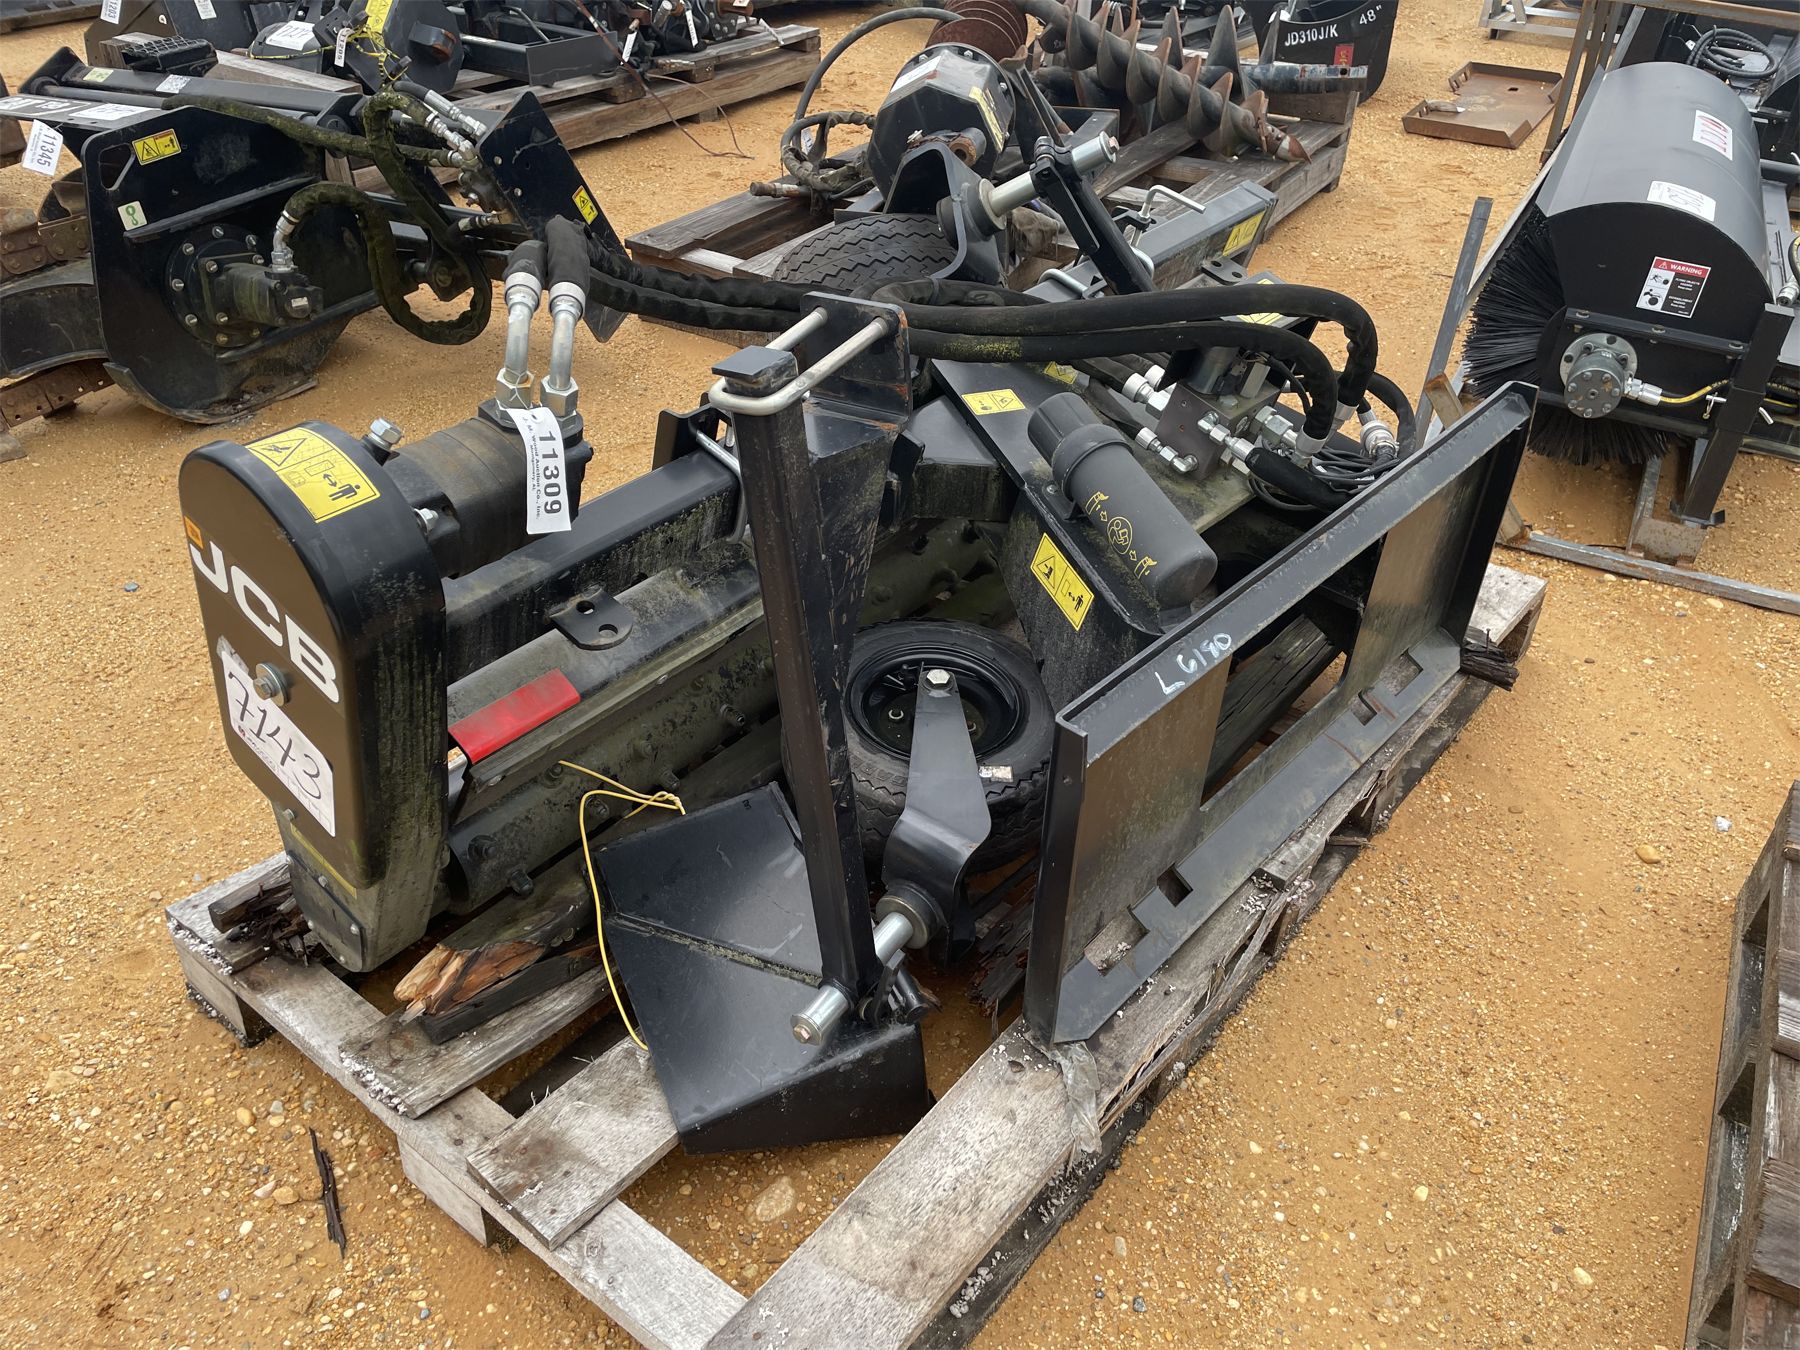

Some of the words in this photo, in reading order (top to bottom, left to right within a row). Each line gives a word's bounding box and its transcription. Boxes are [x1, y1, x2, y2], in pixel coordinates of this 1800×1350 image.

[1359, 4, 1383, 25] 48"
[1284, 24, 1339, 47] JD310J/K
[37, 134, 57, 168] 11345
[1670, 263, 1703, 275] WARNING
[539, 430, 562, 515] 11309
[190, 541, 340, 703] JCB
[228, 671, 322, 800] 7143
